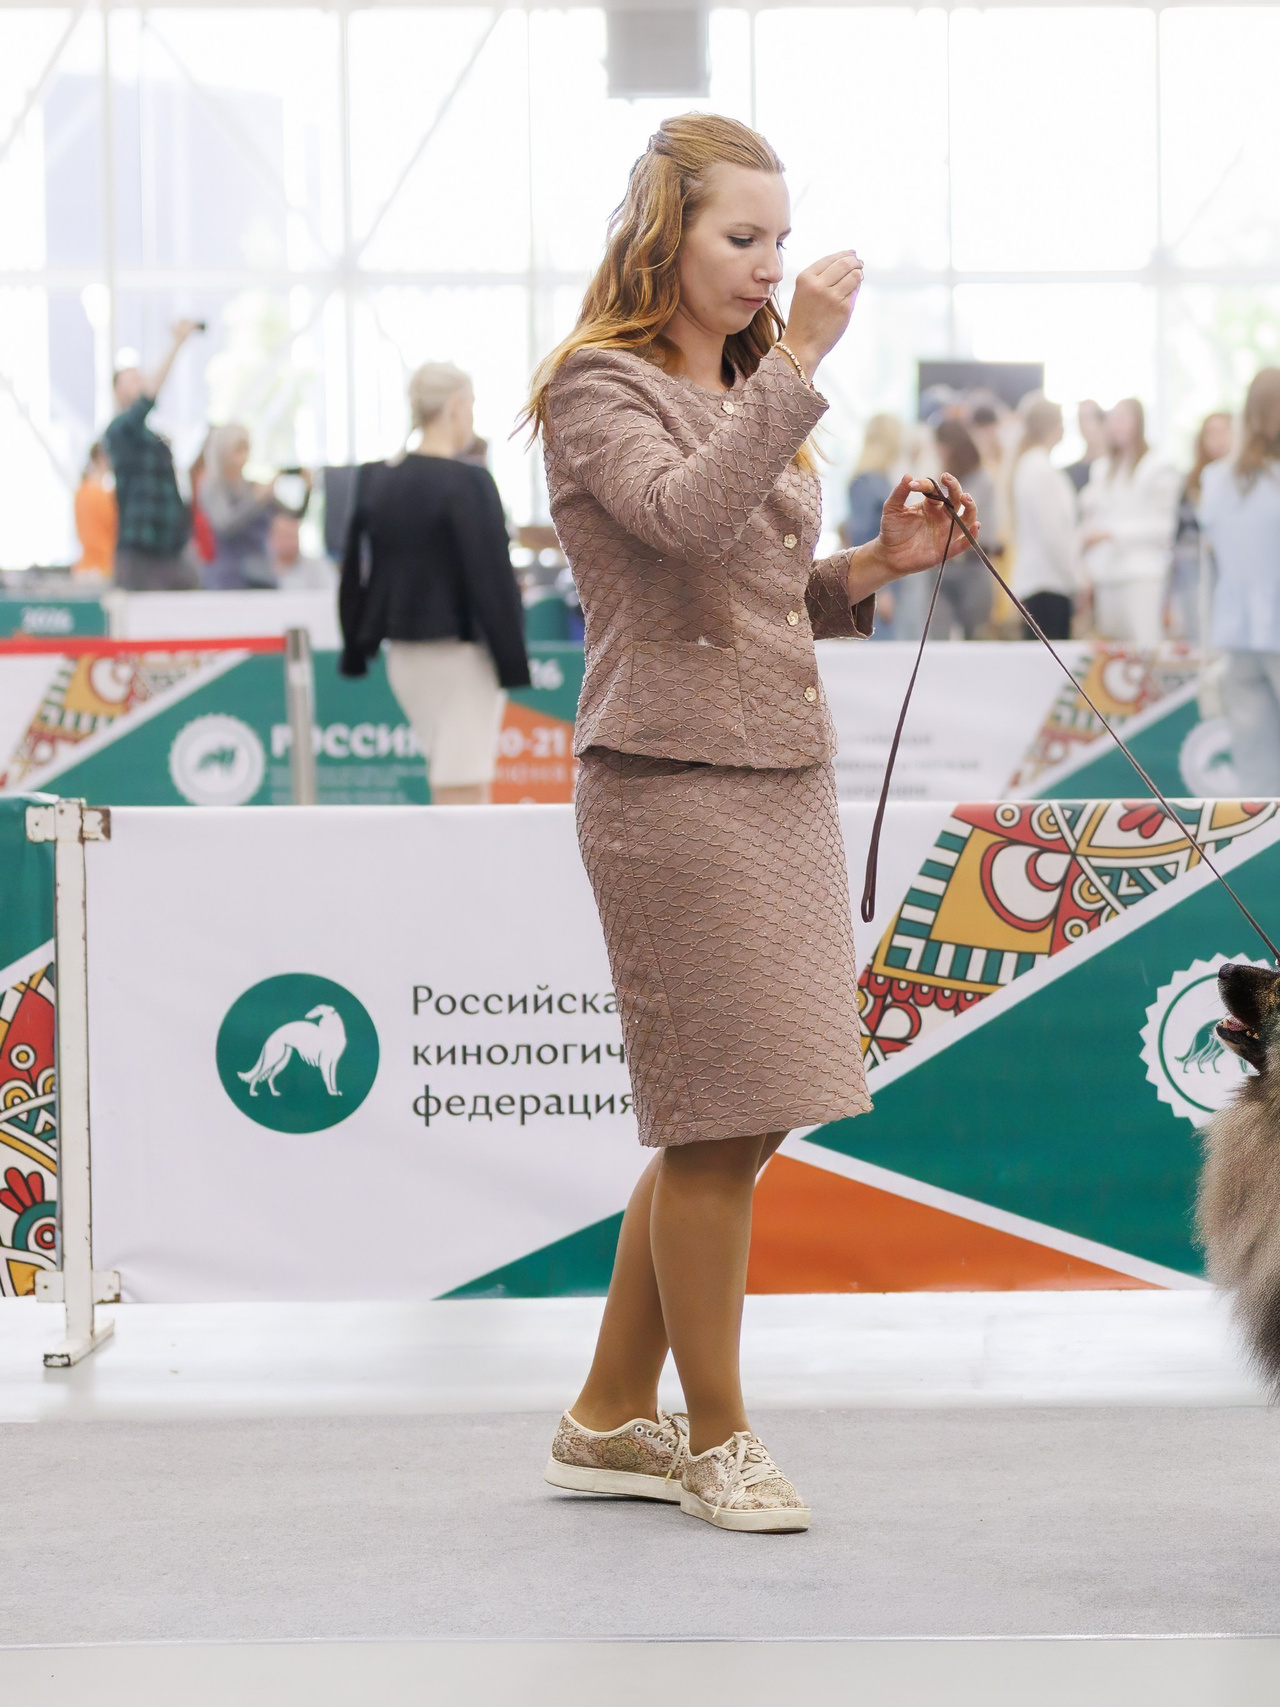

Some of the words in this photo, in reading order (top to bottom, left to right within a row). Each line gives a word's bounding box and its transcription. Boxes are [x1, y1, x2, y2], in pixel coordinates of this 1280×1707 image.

[412, 984, 619, 1015] Российска
[412, 1043, 627, 1066] кинологич
[412, 1084, 634, 1127] федерация
